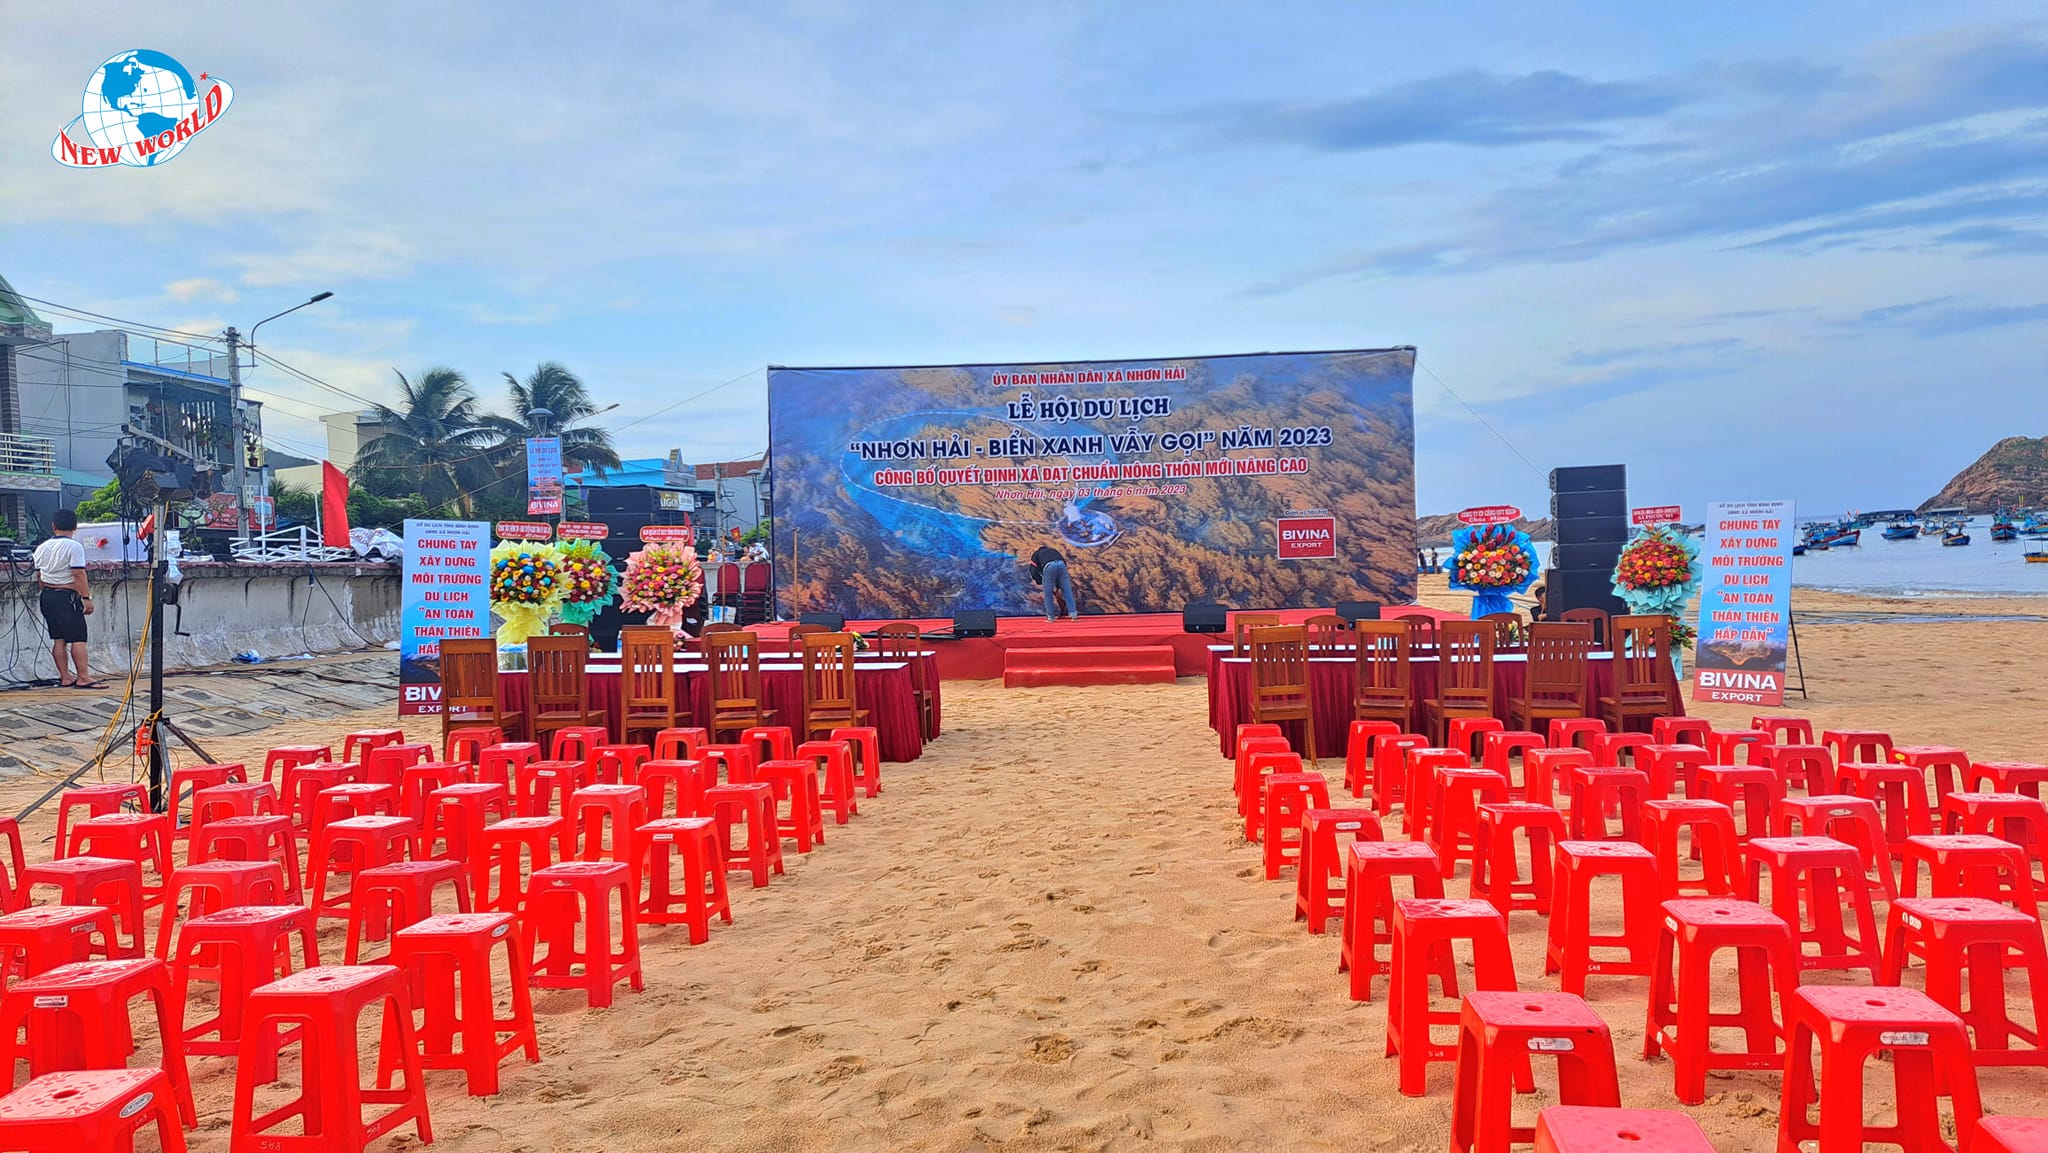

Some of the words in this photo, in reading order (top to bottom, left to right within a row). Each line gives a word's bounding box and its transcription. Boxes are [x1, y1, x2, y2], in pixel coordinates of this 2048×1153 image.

[993, 371, 1008, 385] ỦY
[1012, 374, 1037, 385] BAN
[1040, 371, 1074, 384] NHÂN
[1078, 370, 1103, 383] DÂN
[1107, 369, 1122, 382] XÃ
[1127, 369, 1161, 382] NHƠN
[1164, 365, 1185, 380] HẢI
[1008, 392, 1034, 419] LỄ
[1040, 396, 1078, 422] HỘI
[1084, 400, 1113, 417] DU
[1120, 398, 1170, 420] LỊCH
[933, 434, 970, 457] HẢI
[989, 430, 1034, 456] BIỂN
[1041, 435, 1103, 454] XANH
[1221, 426, 1272, 449] NĂM
[1280, 427, 1332, 446] 2023
[875, 468, 912, 485] CÔNG
[917, 465, 936, 484] BỐ
[938, 465, 981, 485] QUYẾT
[984, 468, 1017, 486] ĐỊNH
[1020, 465, 1038, 482] XÃ
[1043, 467, 1068, 485] ĐẠT
[1072, 459, 1118, 480] CHUẨN
[1123, 461, 1161, 478] NÔNG
[1166, 459, 1201, 476] THÔN
[1206, 457, 1232, 475] MỚI
[1237, 457, 1275, 473] NÂNG
[1280, 458, 1308, 473] CAO
[995, 490, 1023, 499] Nhơn
[1050, 489, 1075, 500] ngày
[1078, 488, 1090, 497] 03
[1093, 487, 1123, 498] tháng
[1126, 486, 1132, 496] 6
[1135, 486, 1158, 495] năm
[1161, 485, 1186, 494] 2023
[530, 501, 558, 509] BIVINA
[1719, 520, 1758, 530] CHUNG
[1762, 519, 1781, 530] TAY
[1282, 529, 1331, 540] BIVINA
[418, 539, 456, 549] CHUNG
[460, 540, 477, 550] TAY
[1720, 536, 1742, 549] XÂY
[1746, 537, 1777, 550] DỰNG
[420, 555, 441, 566] XÂY
[445, 557, 476, 568] DỰNG
[1712, 554, 1734, 566] MÔI
[1738, 554, 1784, 567] TRƯỜNG
[412, 572, 434, 583] MÔI
[438, 573, 482, 585] TRƯỜNG
[1724, 574, 1740, 585] DU
[1743, 574, 1769, 587] LỊCH
[425, 591, 440, 601] DU
[444, 591, 468, 603] LỊCH
[1743, 591, 1774, 604] TOÀN
[445, 608, 474, 619] TOÀN
[1712, 609, 1742, 622] THÂN
[1746, 609, 1779, 624] THIỆN
[414, 624, 444, 637] THÂN
[448, 624, 480, 638] THIỆN
[1715, 626, 1738, 640] HẤP
[1699, 671, 1777, 691] BIVINA
[1711, 691, 1763, 702] EXPORT
